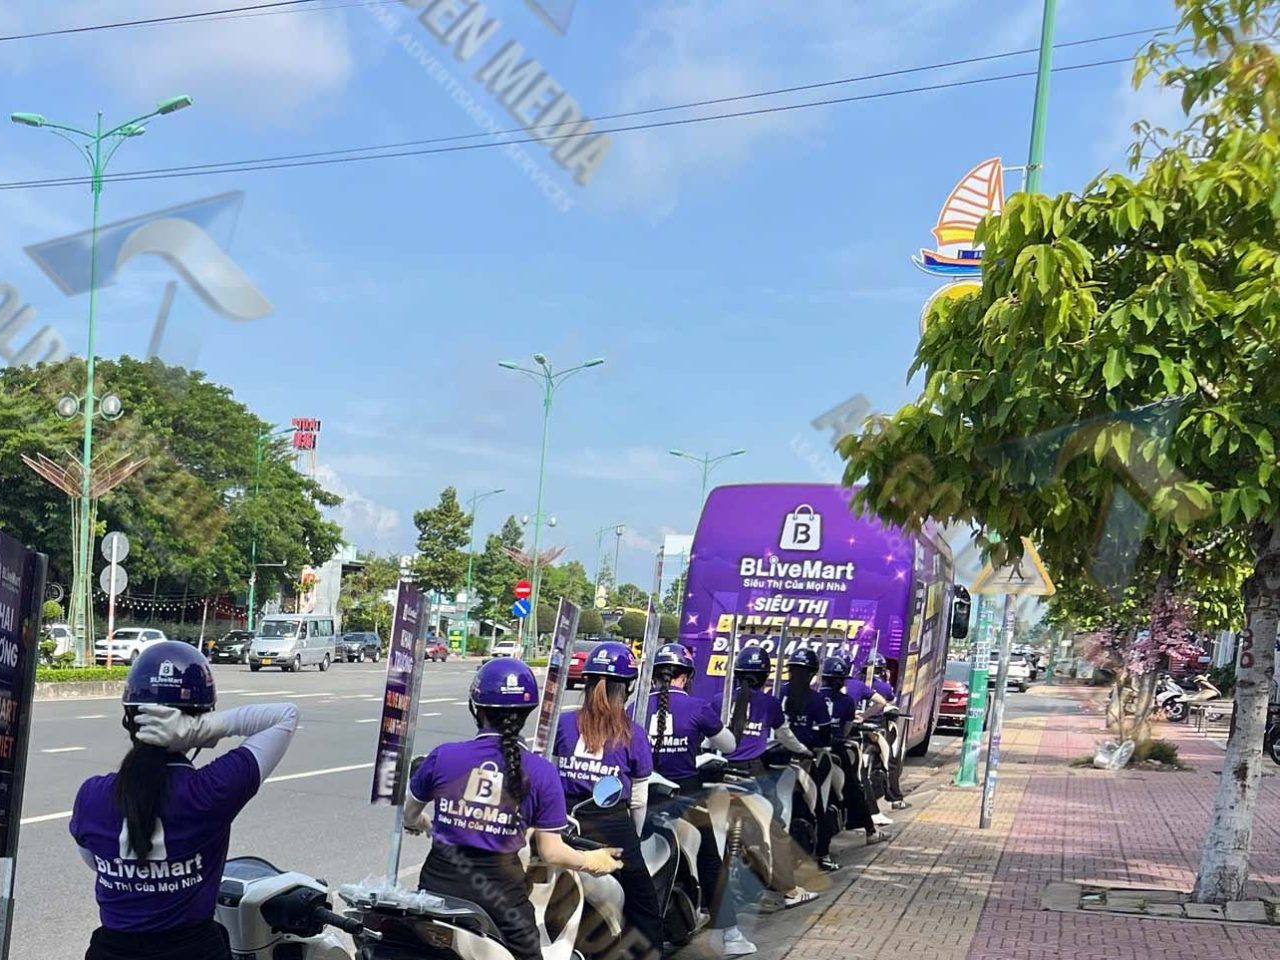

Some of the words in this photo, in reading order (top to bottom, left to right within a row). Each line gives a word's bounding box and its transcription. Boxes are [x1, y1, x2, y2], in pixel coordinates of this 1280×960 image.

[740, 555, 855, 580] BLiveMart
[743, 578, 765, 588] Siêu
[767, 579, 782, 590] Thị
[784, 580, 804, 590] Của
[806, 582, 824, 592] Mọi
[826, 582, 847, 591] Nhà
[754, 594, 794, 613] SIÊU
[797, 600, 829, 618] THỊ
[95, 853, 202, 879] BLiveMart
[115, 881, 132, 893] Thị
[135, 882, 155, 892] Của
[158, 880, 179, 893] Mọi
